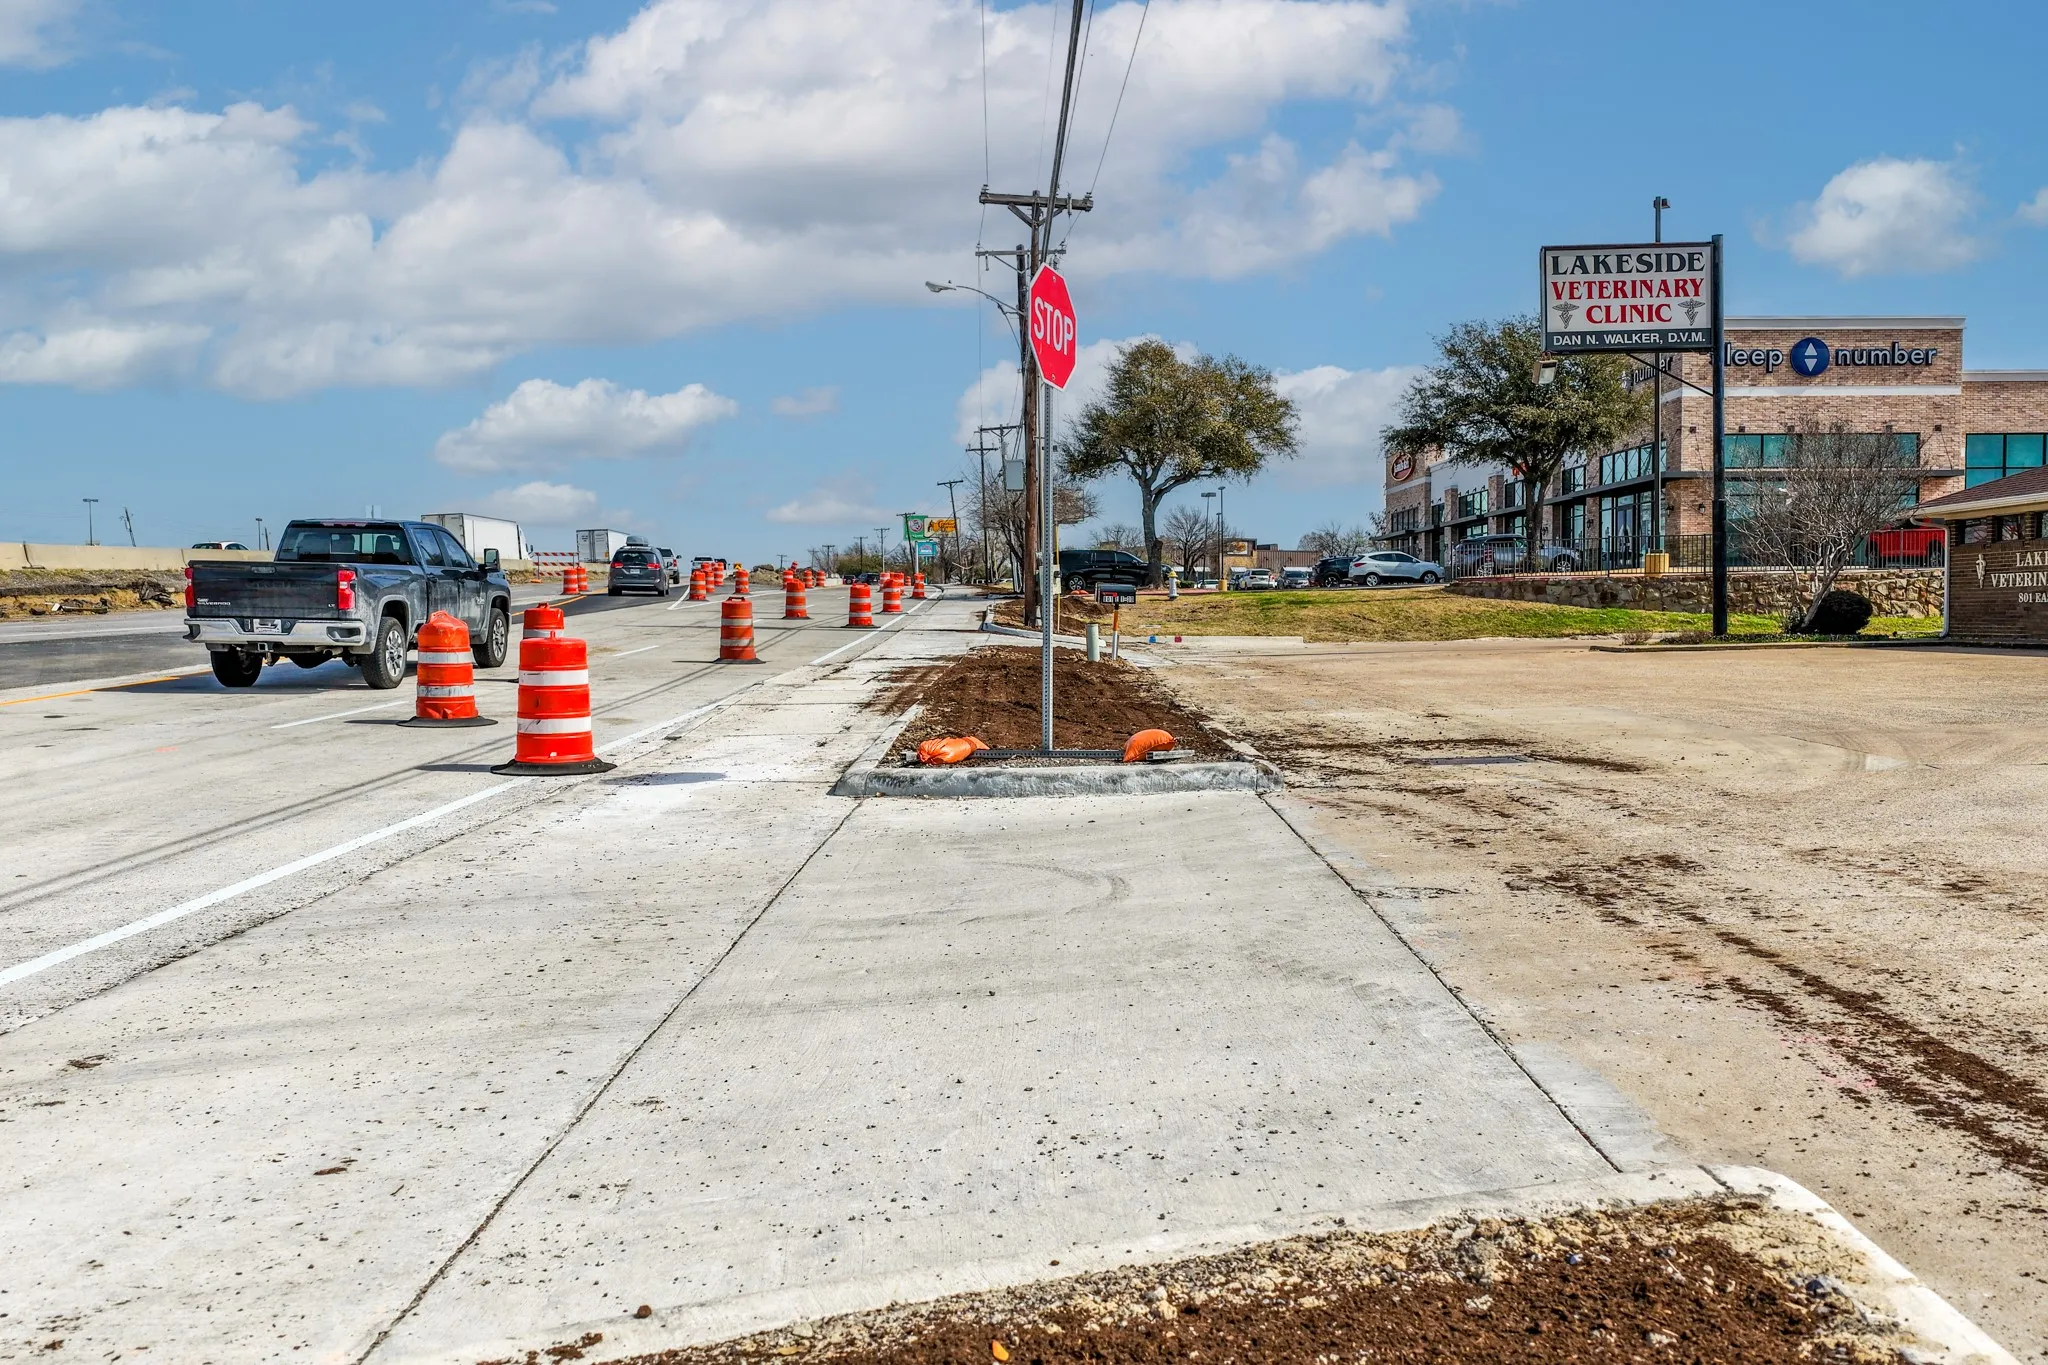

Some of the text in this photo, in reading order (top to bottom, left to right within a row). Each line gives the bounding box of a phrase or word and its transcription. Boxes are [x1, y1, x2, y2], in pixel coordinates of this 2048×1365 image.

[1551, 252, 1705, 275] LAKESIDE
[1551, 278, 1704, 300] VETERINARY
[1586, 303, 1673, 324] CLINIC
[1033, 296, 1074, 356] STOP
[1553, 331, 1706, 346] DAN N. WALKER, D.V.M.
[1709, 341, 1937, 373] leep number
[1633, 357, 1673, 385] numer
[1991, 572, 2048, 587] VETERIN
[2018, 592, 2048, 603] 801 EA
